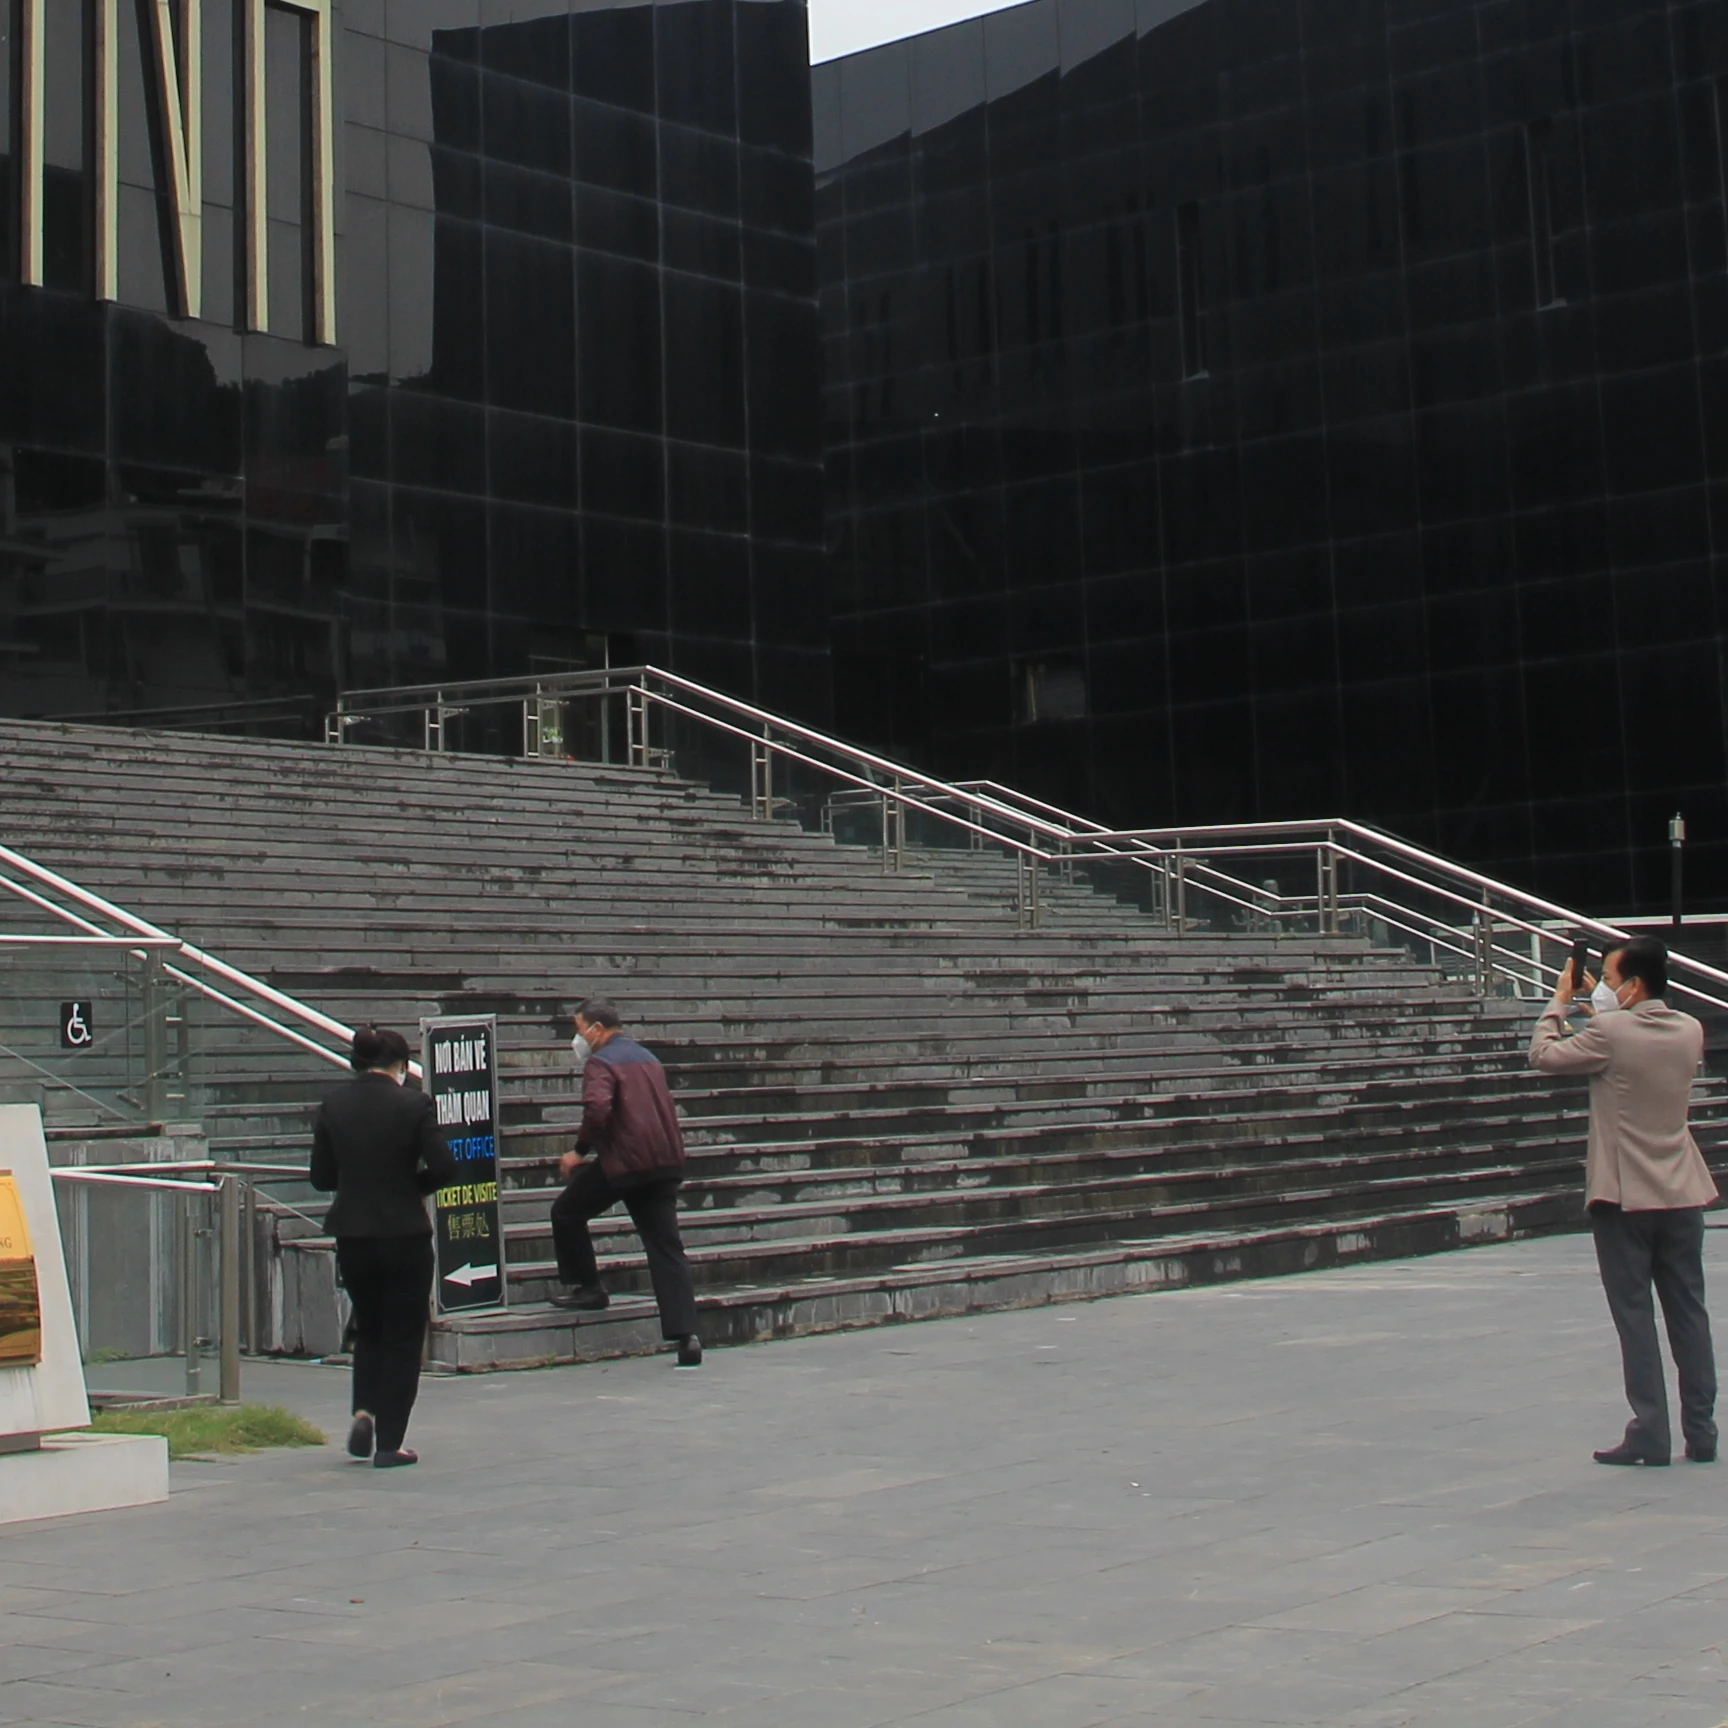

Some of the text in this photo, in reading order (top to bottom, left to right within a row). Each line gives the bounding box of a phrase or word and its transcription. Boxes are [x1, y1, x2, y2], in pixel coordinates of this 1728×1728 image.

[453, 1034, 473, 1072] BÁN
[474, 1032, 487, 1070] VÉ
[463, 1090, 490, 1126] QUAN
[465, 1135, 495, 1160] OFFICE
[436, 1181, 499, 1208] TICKET DE VISITE
